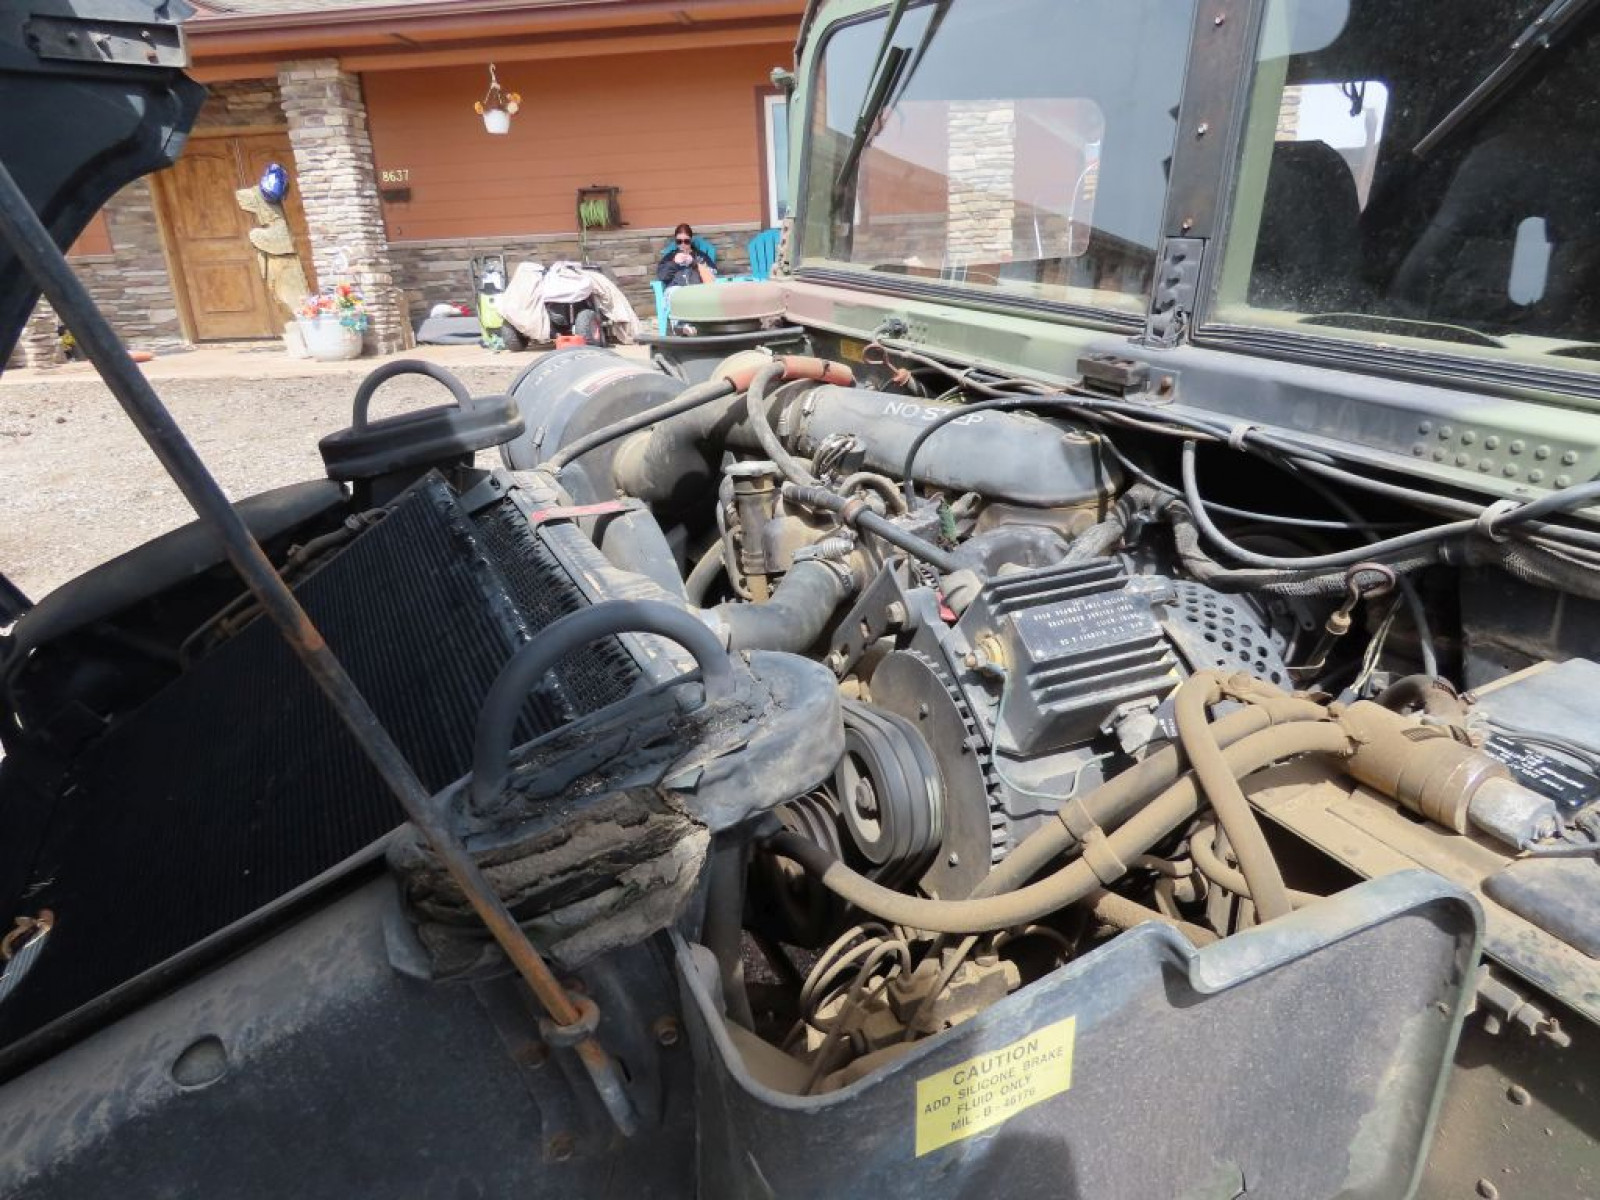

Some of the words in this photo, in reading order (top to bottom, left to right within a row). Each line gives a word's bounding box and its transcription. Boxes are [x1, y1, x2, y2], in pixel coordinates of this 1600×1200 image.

[382, 169, 409, 182] 8637
[882, 401, 920, 418] NO
[924, 1096, 951, 1115] ADD
[957, 1067, 1015, 1098] SILICONE
[1022, 1046, 1064, 1072] BRAKE
[952, 1039, 1039, 1086] CAUTION
[957, 1090, 993, 1115] FLUID
[1000, 1075, 1032, 1096] ONLY
